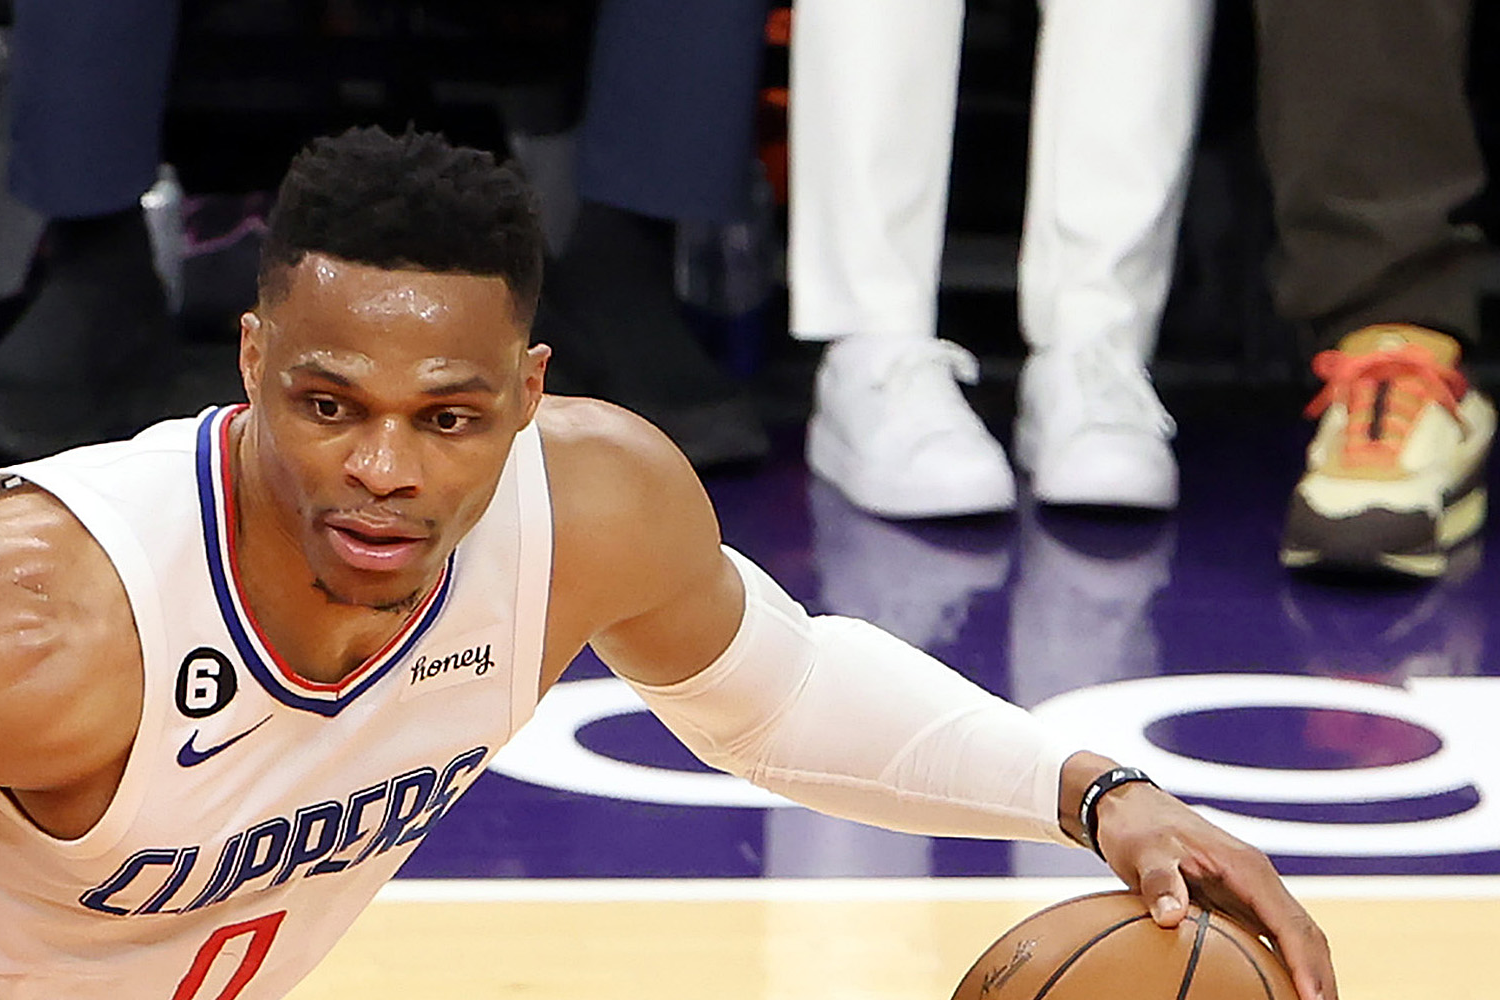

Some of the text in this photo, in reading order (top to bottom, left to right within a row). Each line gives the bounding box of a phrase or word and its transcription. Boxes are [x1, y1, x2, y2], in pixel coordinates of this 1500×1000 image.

[184, 657, 220, 711] 6
[410, 642, 495, 686] honey
[78, 746, 490, 916] CLIPPERS
